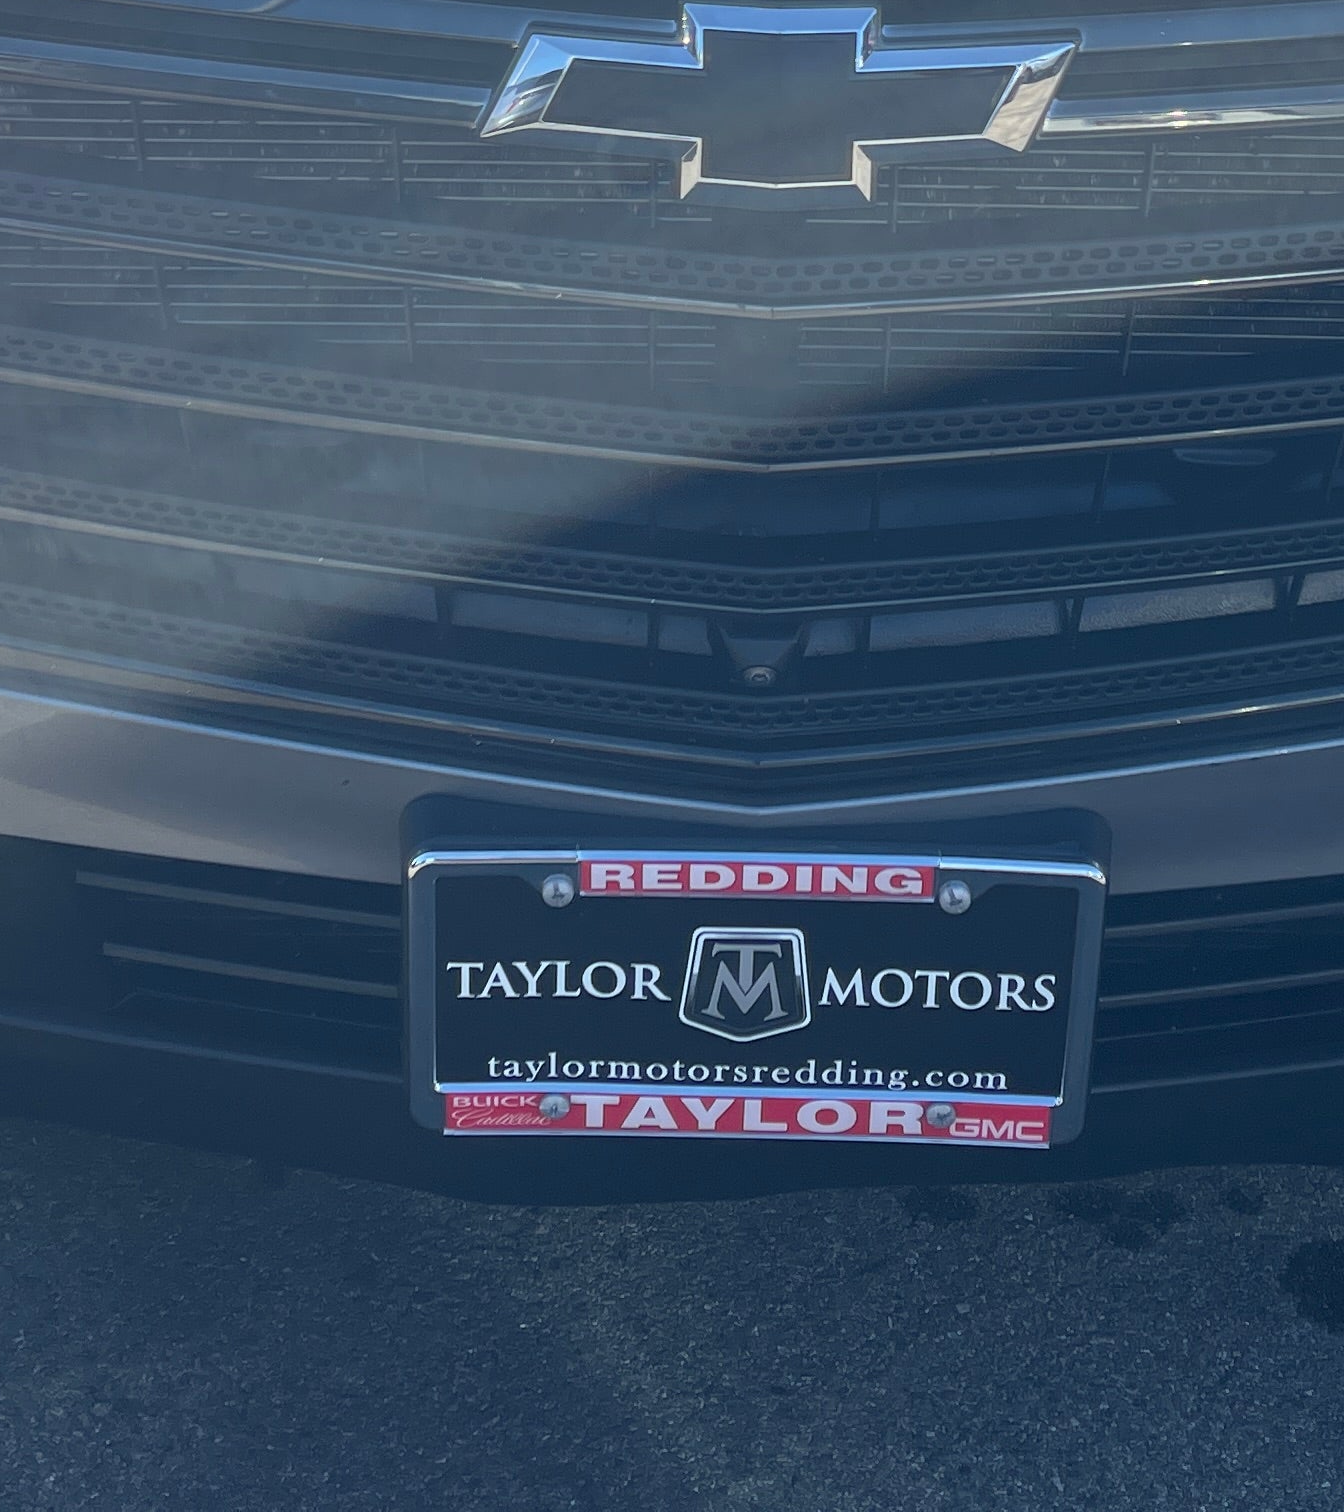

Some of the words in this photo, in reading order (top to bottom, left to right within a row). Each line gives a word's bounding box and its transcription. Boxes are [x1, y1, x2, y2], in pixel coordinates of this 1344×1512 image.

[590, 863, 923, 895] REDDING
[447, 961, 671, 1002] TAYLOR
[817, 968, 1056, 1012] MOTORS
[487, 1051, 1008, 1091] taylormotorsredding.com
[453, 1095, 537, 1108] BUICK
[570, 1095, 924, 1135] TAYLOR
[451, 1108, 552, 1128] Cadillac
[949, 1118, 1044, 1141] GMC
